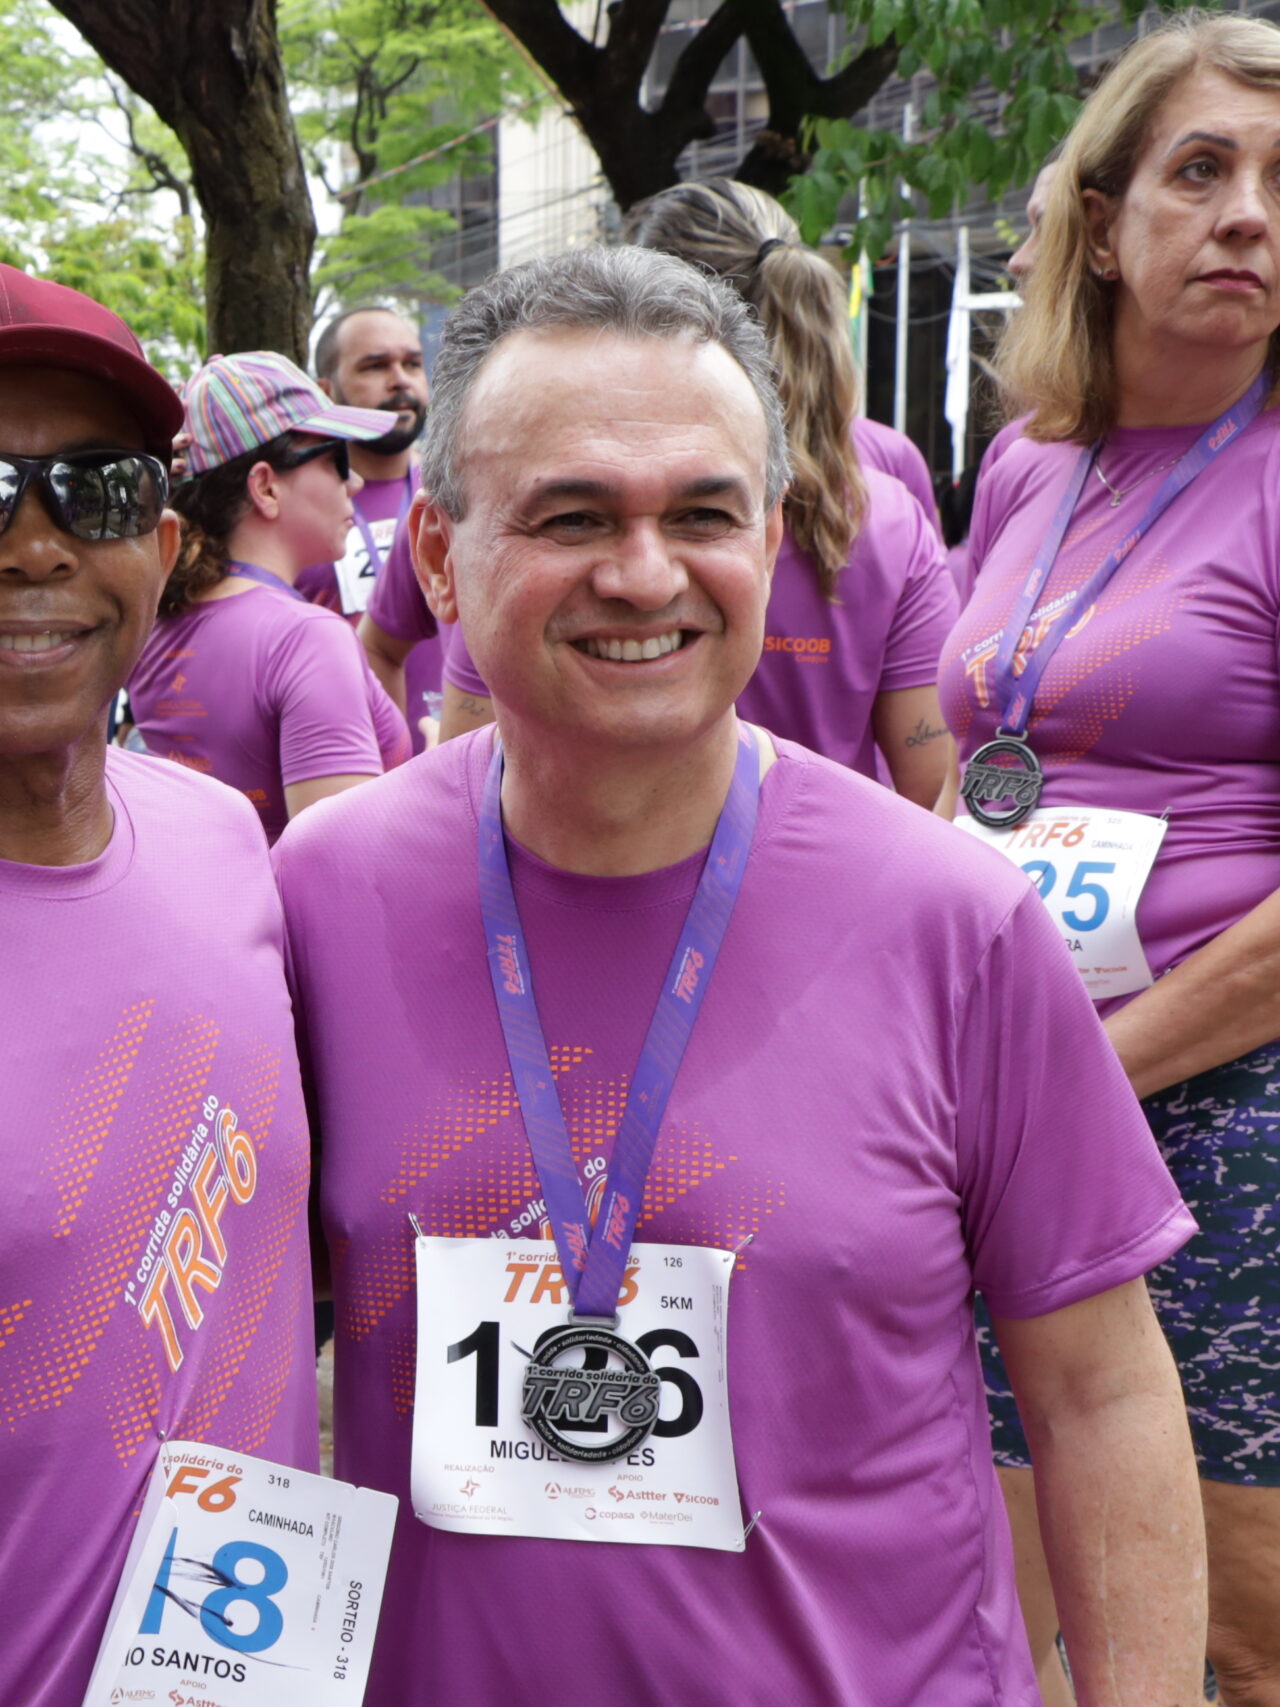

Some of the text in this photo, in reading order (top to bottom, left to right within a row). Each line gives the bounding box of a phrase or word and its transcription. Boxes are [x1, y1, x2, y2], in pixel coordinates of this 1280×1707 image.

[763, 635, 832, 653] SICOOB
[960, 770, 1043, 807] TRF6
[1004, 823, 1090, 849] TRF6
[676, 948, 705, 1004] TRF6
[583, 1156, 607, 1179] do
[136, 1209, 171, 1284] corrida
[167, 1121, 209, 1209] solidária
[202, 1094, 220, 1121] do
[138, 1107, 257, 1374] TRF6
[663, 1256, 683, 1269] 126
[503, 1262, 641, 1308] TR6
[660, 1295, 693, 1311] 5KM
[539, 1367, 583, 1380] corrida
[586, 1370, 640, 1384] solidária
[642, 1374, 659, 1385] do
[522, 1377, 661, 1428] TRF6
[168, 1453, 243, 1475] solidária do
[444, 1463, 495, 1474] REALIZAÇÃO
[268, 1474, 291, 1489] 318
[616, 1473, 643, 1483] APOIO
[626, 1489, 667, 1502] Asttter
[685, 1493, 719, 1506] SICOOB
[431, 1503, 467, 1514] JUSTIÇA
[469, 1504, 508, 1516] FEDERAL
[599, 1510, 635, 1521] copasa
[248, 1508, 315, 1538] CAMINHADA
[340, 1580, 363, 1644] SORTEIO
[150, 1647, 248, 1683] SANTOS
[333, 1655, 349, 1681] 318
[179, 1678, 208, 1690] APOIO
